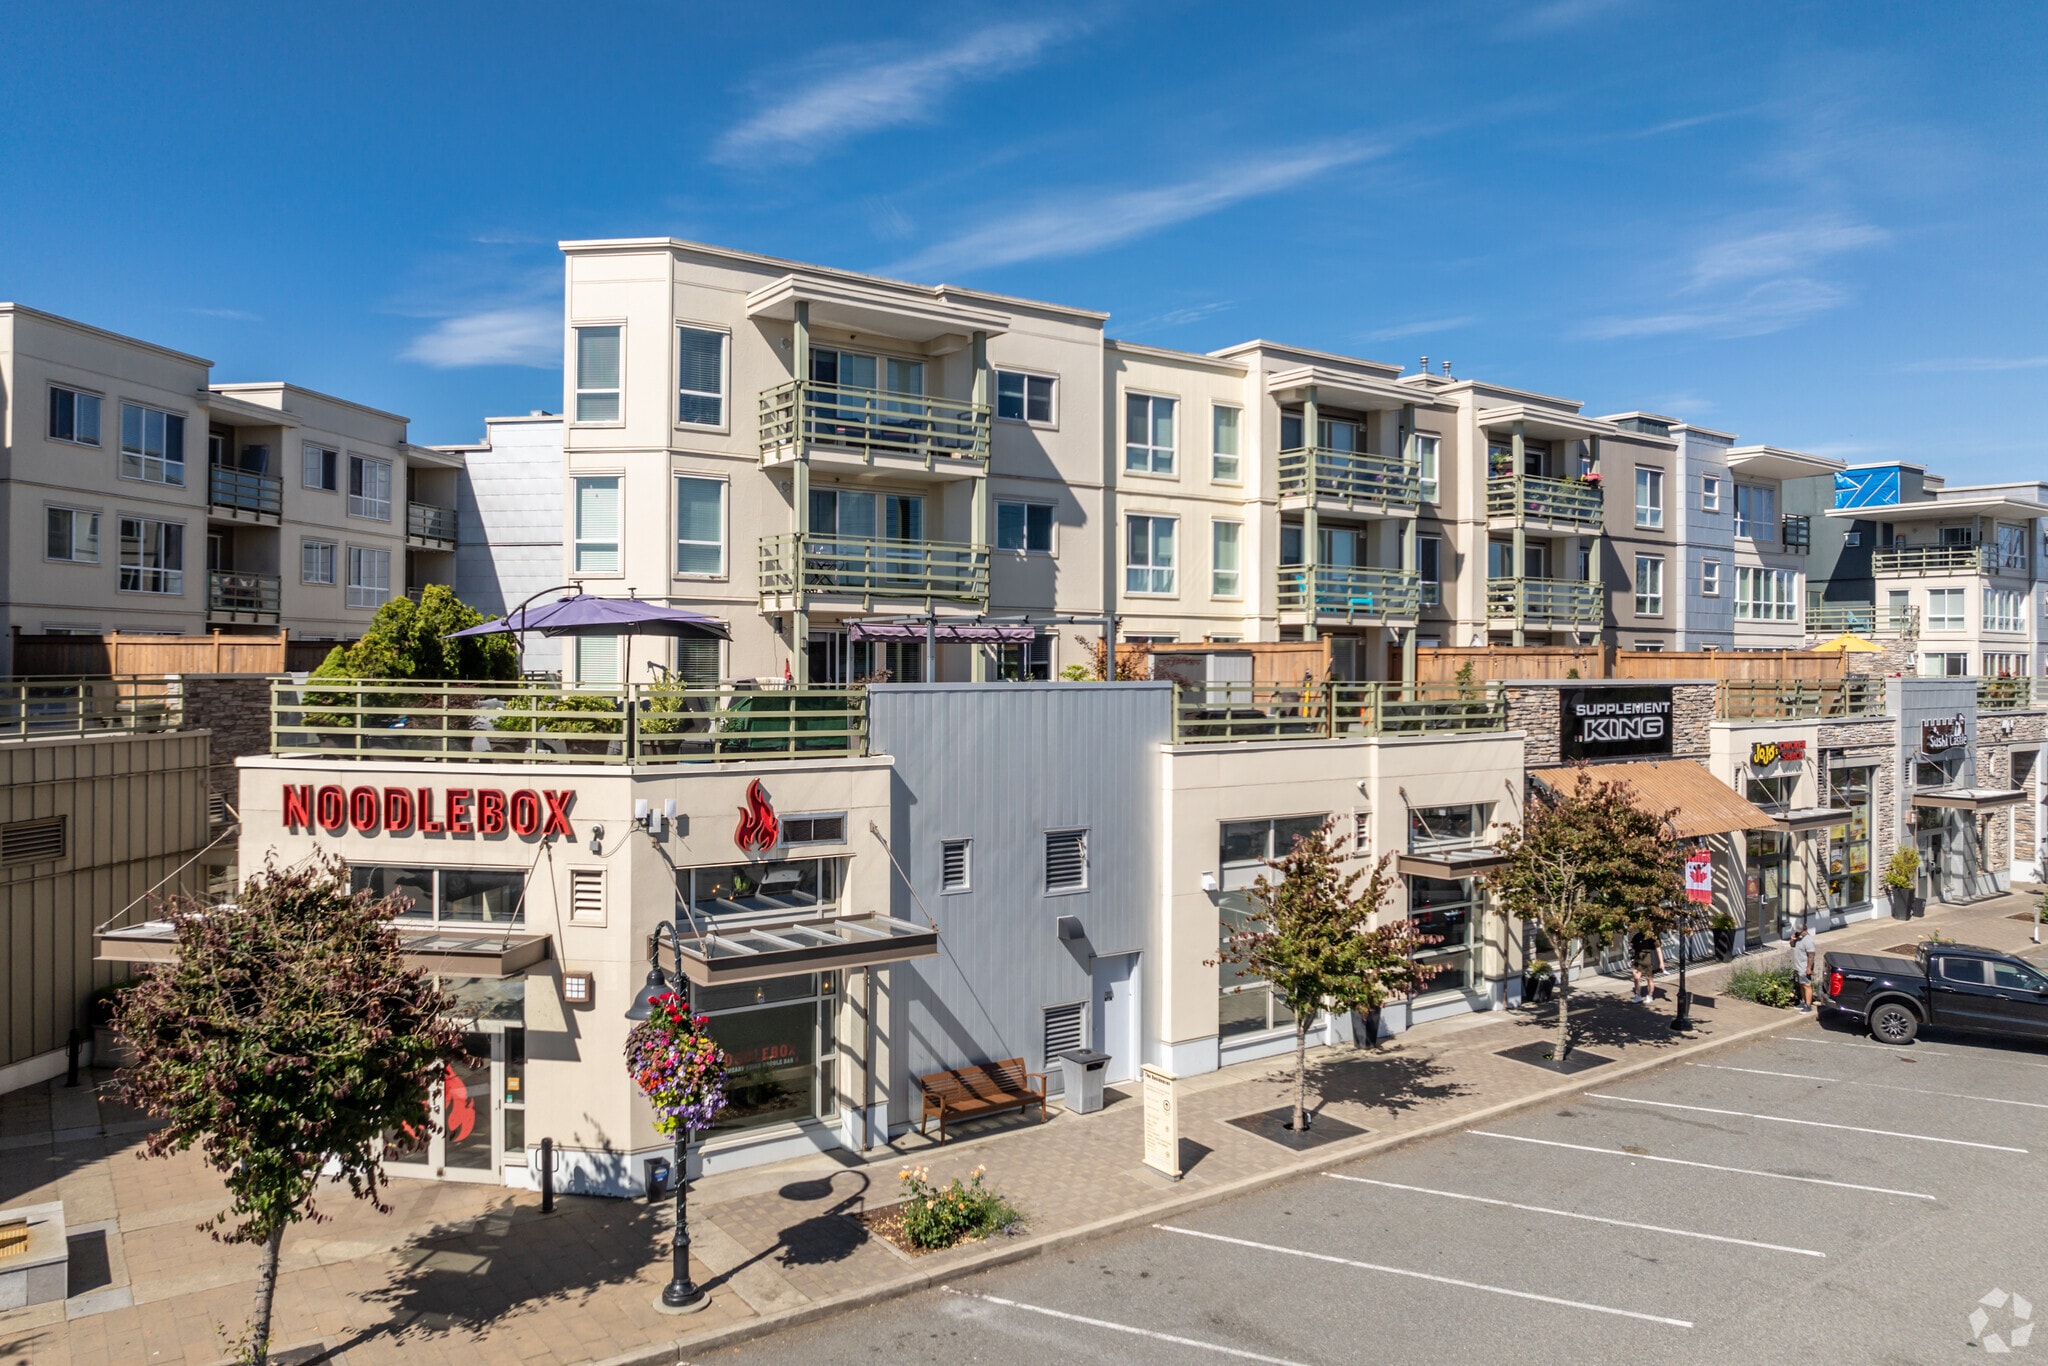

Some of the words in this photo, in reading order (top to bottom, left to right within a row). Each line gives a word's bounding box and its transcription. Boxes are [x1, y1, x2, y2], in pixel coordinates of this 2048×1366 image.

[1576, 702, 1671, 716] SUPPLEMENT
[1584, 716, 1664, 742] KING
[1779, 741, 1806, 750] CHICKEN
[1930, 735, 1948, 747] Sushi
[1950, 734, 1967, 745] Castle
[1782, 751, 1803, 761] SHACK
[282, 784, 574, 836] NOODLEBOX
